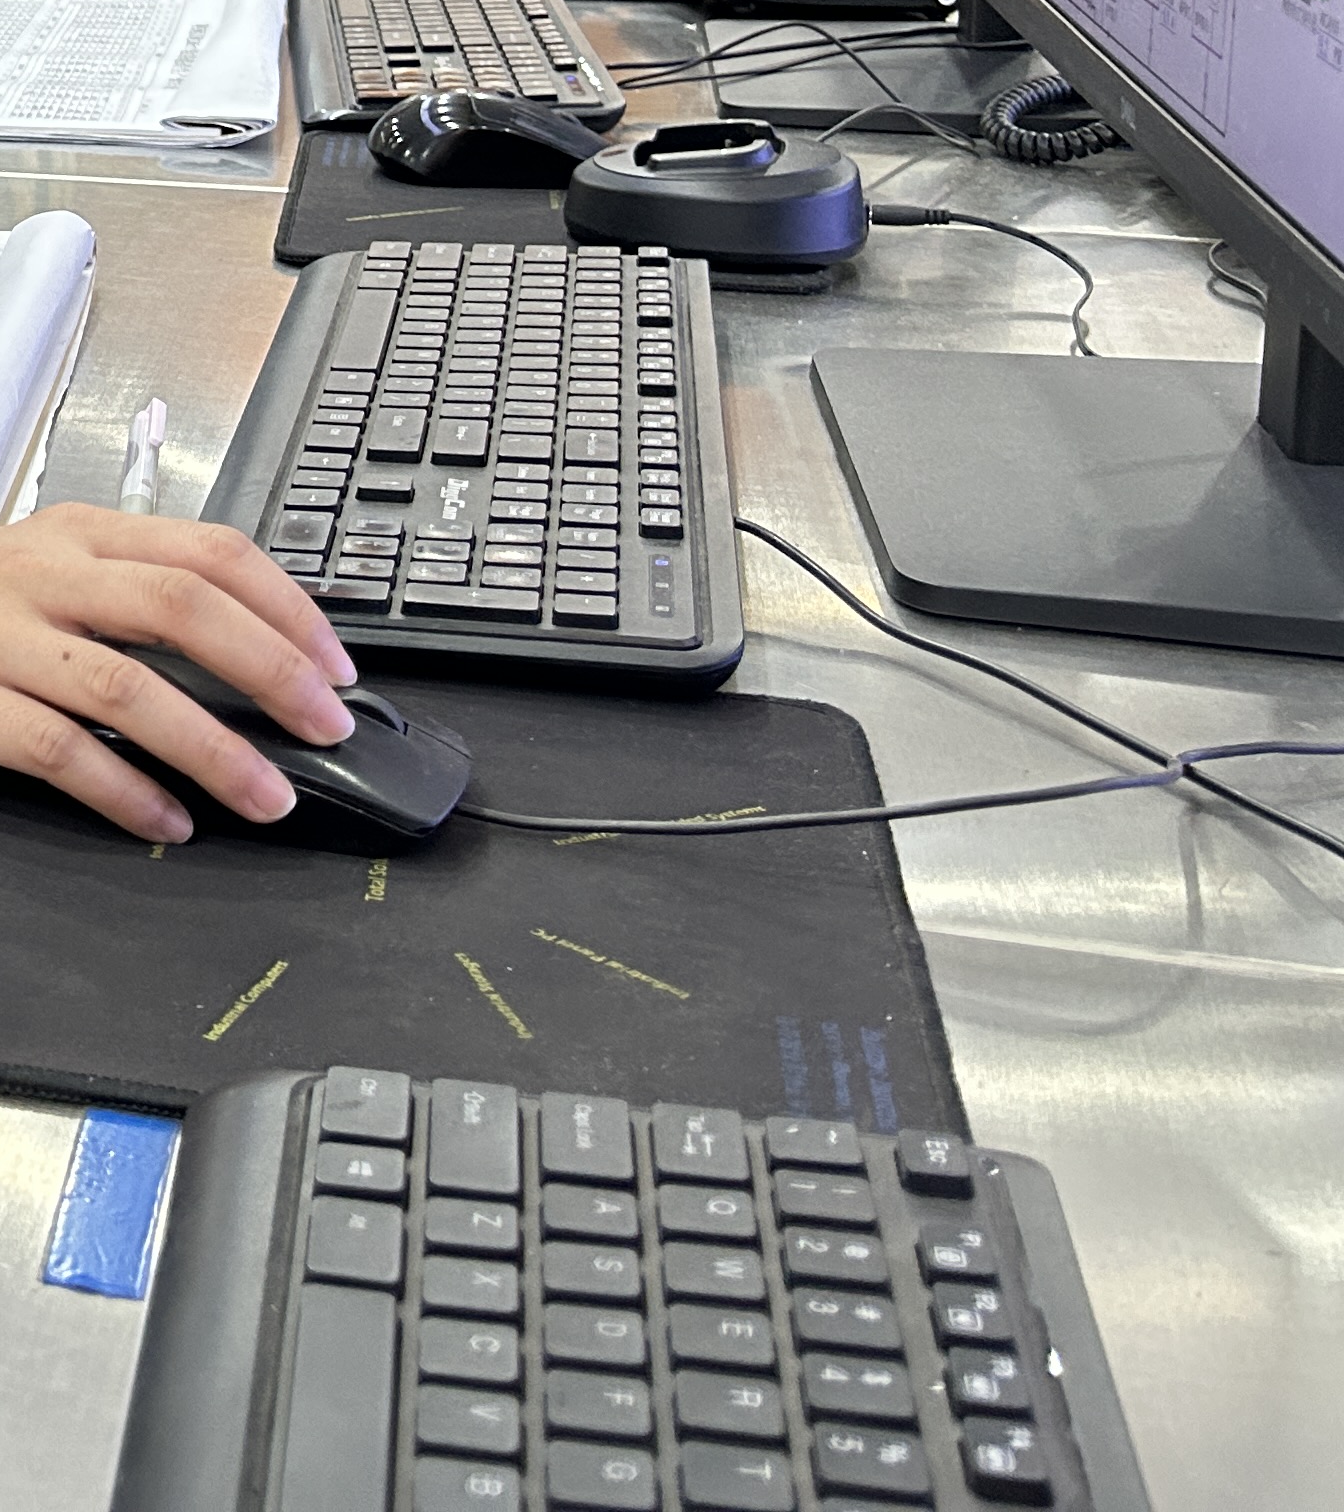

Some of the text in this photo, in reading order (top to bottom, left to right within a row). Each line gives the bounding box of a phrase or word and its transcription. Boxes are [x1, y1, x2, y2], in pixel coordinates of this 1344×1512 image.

[364, 876, 386, 901] Total
[529, 928, 691, 1000] Industrial Panel PC
[202, 960, 289, 1041] Industrial Computers
[485, 993, 534, 1039] Industrial
[595, 1200, 622, 1214] A
[707, 1199, 738, 1215] Q
[472, 1212, 503, 1229] Z
[797, 1238, 829, 1253] 2
[593, 1257, 624, 1272] S
[715, 1260, 745, 1279] W
[473, 1272, 501, 1287] X
[808, 1300, 840, 1314] 3
[597, 1321, 628, 1337] D
[721, 1321, 754, 1338] E
[469, 1335, 501, 1354] C
[820, 1367, 849, 1381] 4
[603, 1392, 635, 1406] F
[733, 1389, 763, 1408] R
[469, 1405, 501, 1422] V
[829, 1434, 864, 1453] 5
[605, 1461, 638, 1481] G
[739, 1461, 773, 1481] T
[469, 1476, 504, 1497] B
